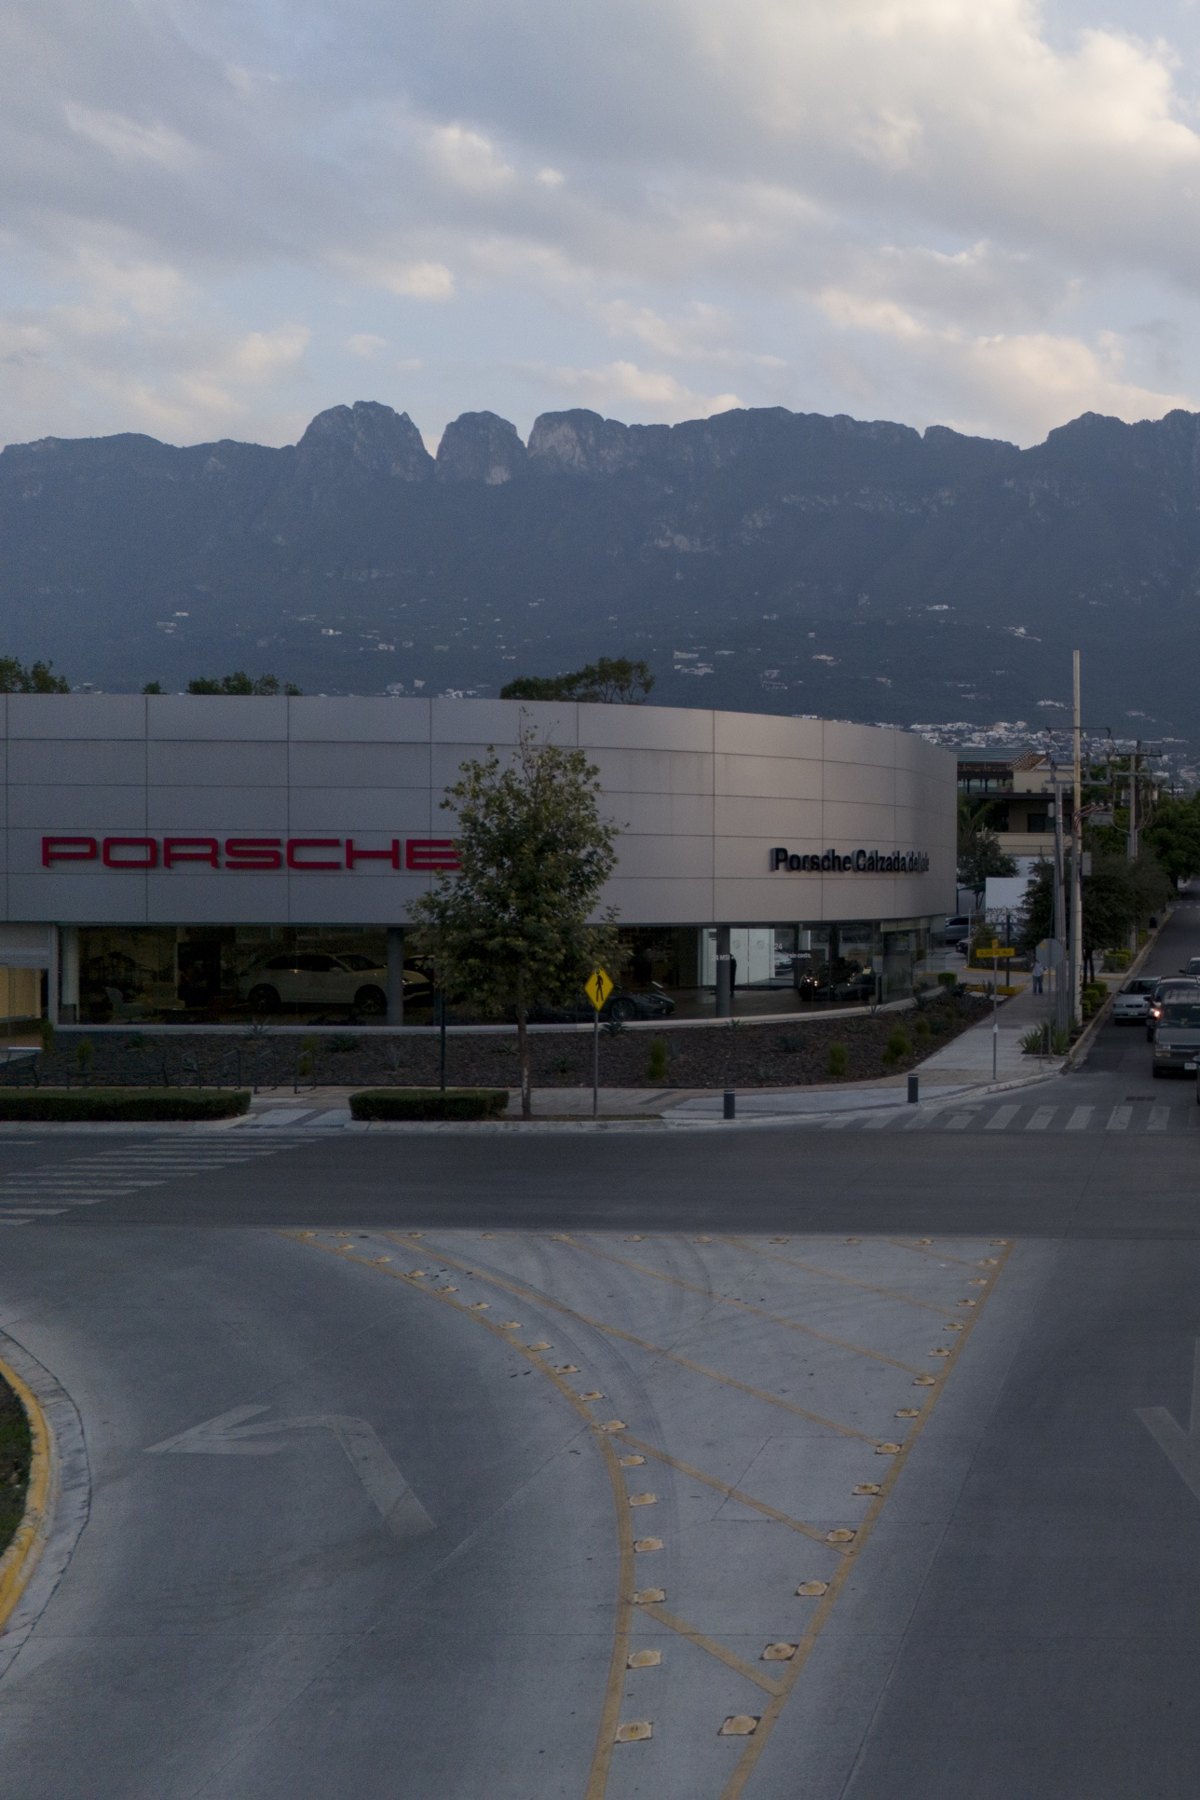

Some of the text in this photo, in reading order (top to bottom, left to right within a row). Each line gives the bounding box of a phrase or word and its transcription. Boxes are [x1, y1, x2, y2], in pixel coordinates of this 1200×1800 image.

[42, 836, 464, 869] PORSCHE
[771, 847, 851, 872] Porsche
[853, 849, 906, 872] Calzada
